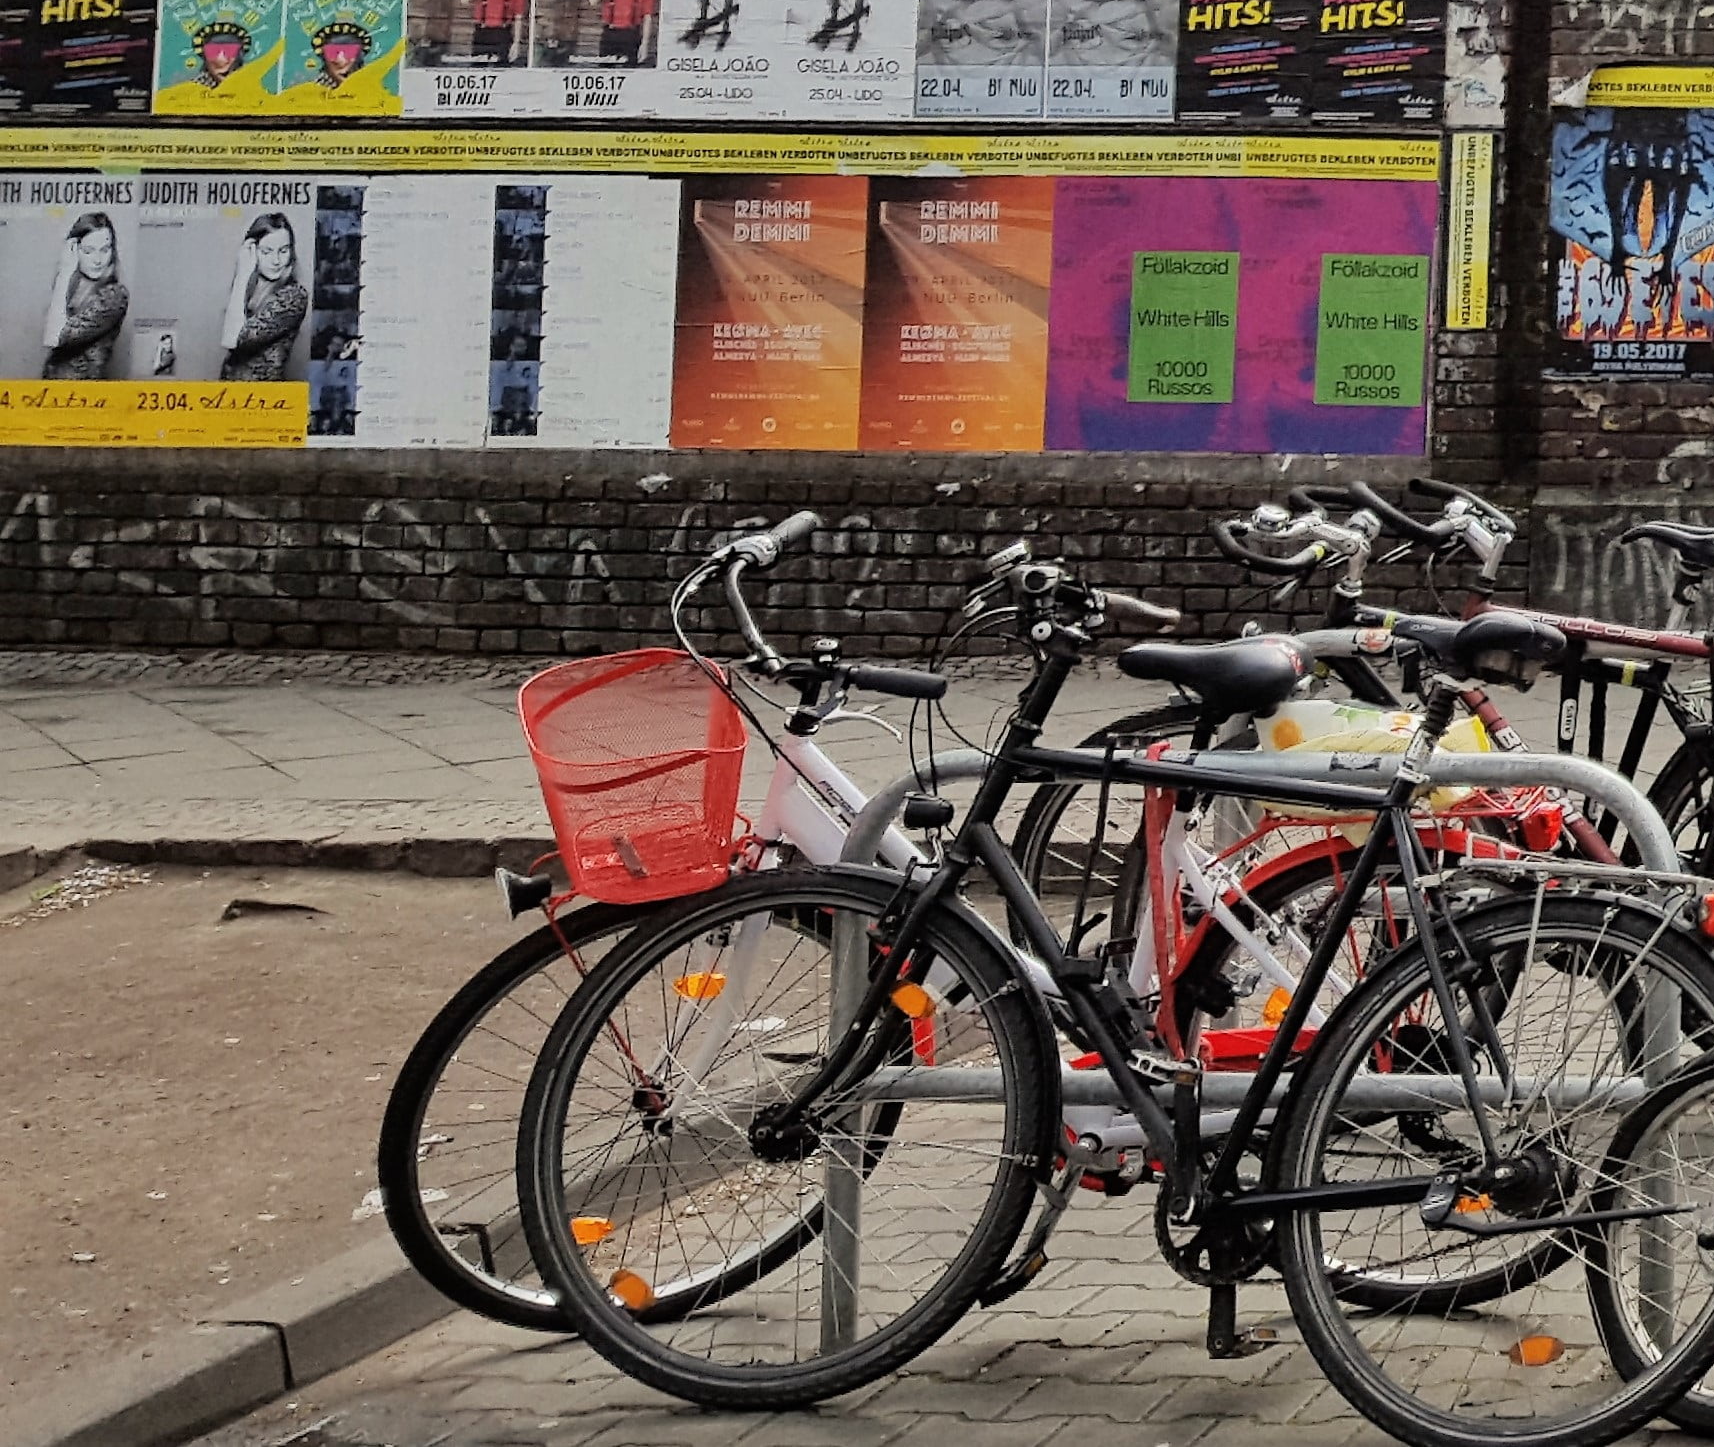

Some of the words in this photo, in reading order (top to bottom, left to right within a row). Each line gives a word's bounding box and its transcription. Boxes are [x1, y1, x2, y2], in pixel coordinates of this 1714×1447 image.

[1188, 1, 1272, 31] HITS!
[1321, 1, 1405, 33] HITS!
[667, 58, 718, 72] GISELA
[722, 56, 770, 73] JOÃO
[797, 59, 849, 74] GISELA
[854, 57, 900, 74] JOÃO
[434, 75, 497, 91] 10.06.17
[562, 76, 625, 91] 10.06.17
[921, 78, 963, 98] 22.04.
[1052, 79, 1095, 99] 22.04.
[1626, 83, 1681, 93] BEKLEBEN
[413, 146, 466, 155] VERBOTEN
[467, 146, 536, 156] UNBEFUGTES
[539, 147, 593, 157] BEKLEBEN
[596, 147, 650, 157] VERBOTEN
[651, 148, 720, 158] UNBEFUGTES
[723, 148, 777, 158] BEKLEBEN
[779, 149, 835, 160] VERBOTEN
[838, 150, 907, 160] UNBEFUGTES
[910, 151, 964, 161] BEKLEBEN
[967, 151, 1023, 161] VERBOTEN
[1025, 151, 1095, 162] UNBEFUGTES
[1098, 152, 1153, 162] BEKLEBEN
[1154, 152, 1213, 162] VERBOTEN
[1245, 154, 1317, 164] UNBEFUGTES
[1320, 155, 1376, 165] BEKLEBEN
[1378, 156, 1436, 166] VERBOTEN
[31, 181, 133, 204] HOLOFERNES
[140, 182, 198, 205] JUDITH
[207, 182, 311, 205] HOLOFERNES
[735, 200, 812, 219] REMMI
[920, 201, 998, 220] REMMI
[734, 224, 811, 243] DEMMI
[920, 224, 998, 243] DEMMI
[1464, 209, 1475, 264] BEKLEBEN
[1142, 256, 1229, 276] Föllakzoid
[1331, 260, 1419, 279] Föllakzoid
[1461, 267, 1473, 326] VERBOTEN
[1137, 310, 1191, 328] White
[1194, 310, 1229, 328] Hills
[1326, 312, 1377, 330] White
[1384, 312, 1419, 331] Hills
[1592, 343, 1687, 360] 19.05.2017
[1155, 361, 1207, 378] 10000
[1342, 364, 1395, 381] 10000
[1148, 379, 1213, 396] Russos
[1336, 381, 1401, 399] Russos
[22, 387, 108, 411] Astra
[137, 392, 193, 412] 23.04.
[200, 387, 294, 411] Astra
